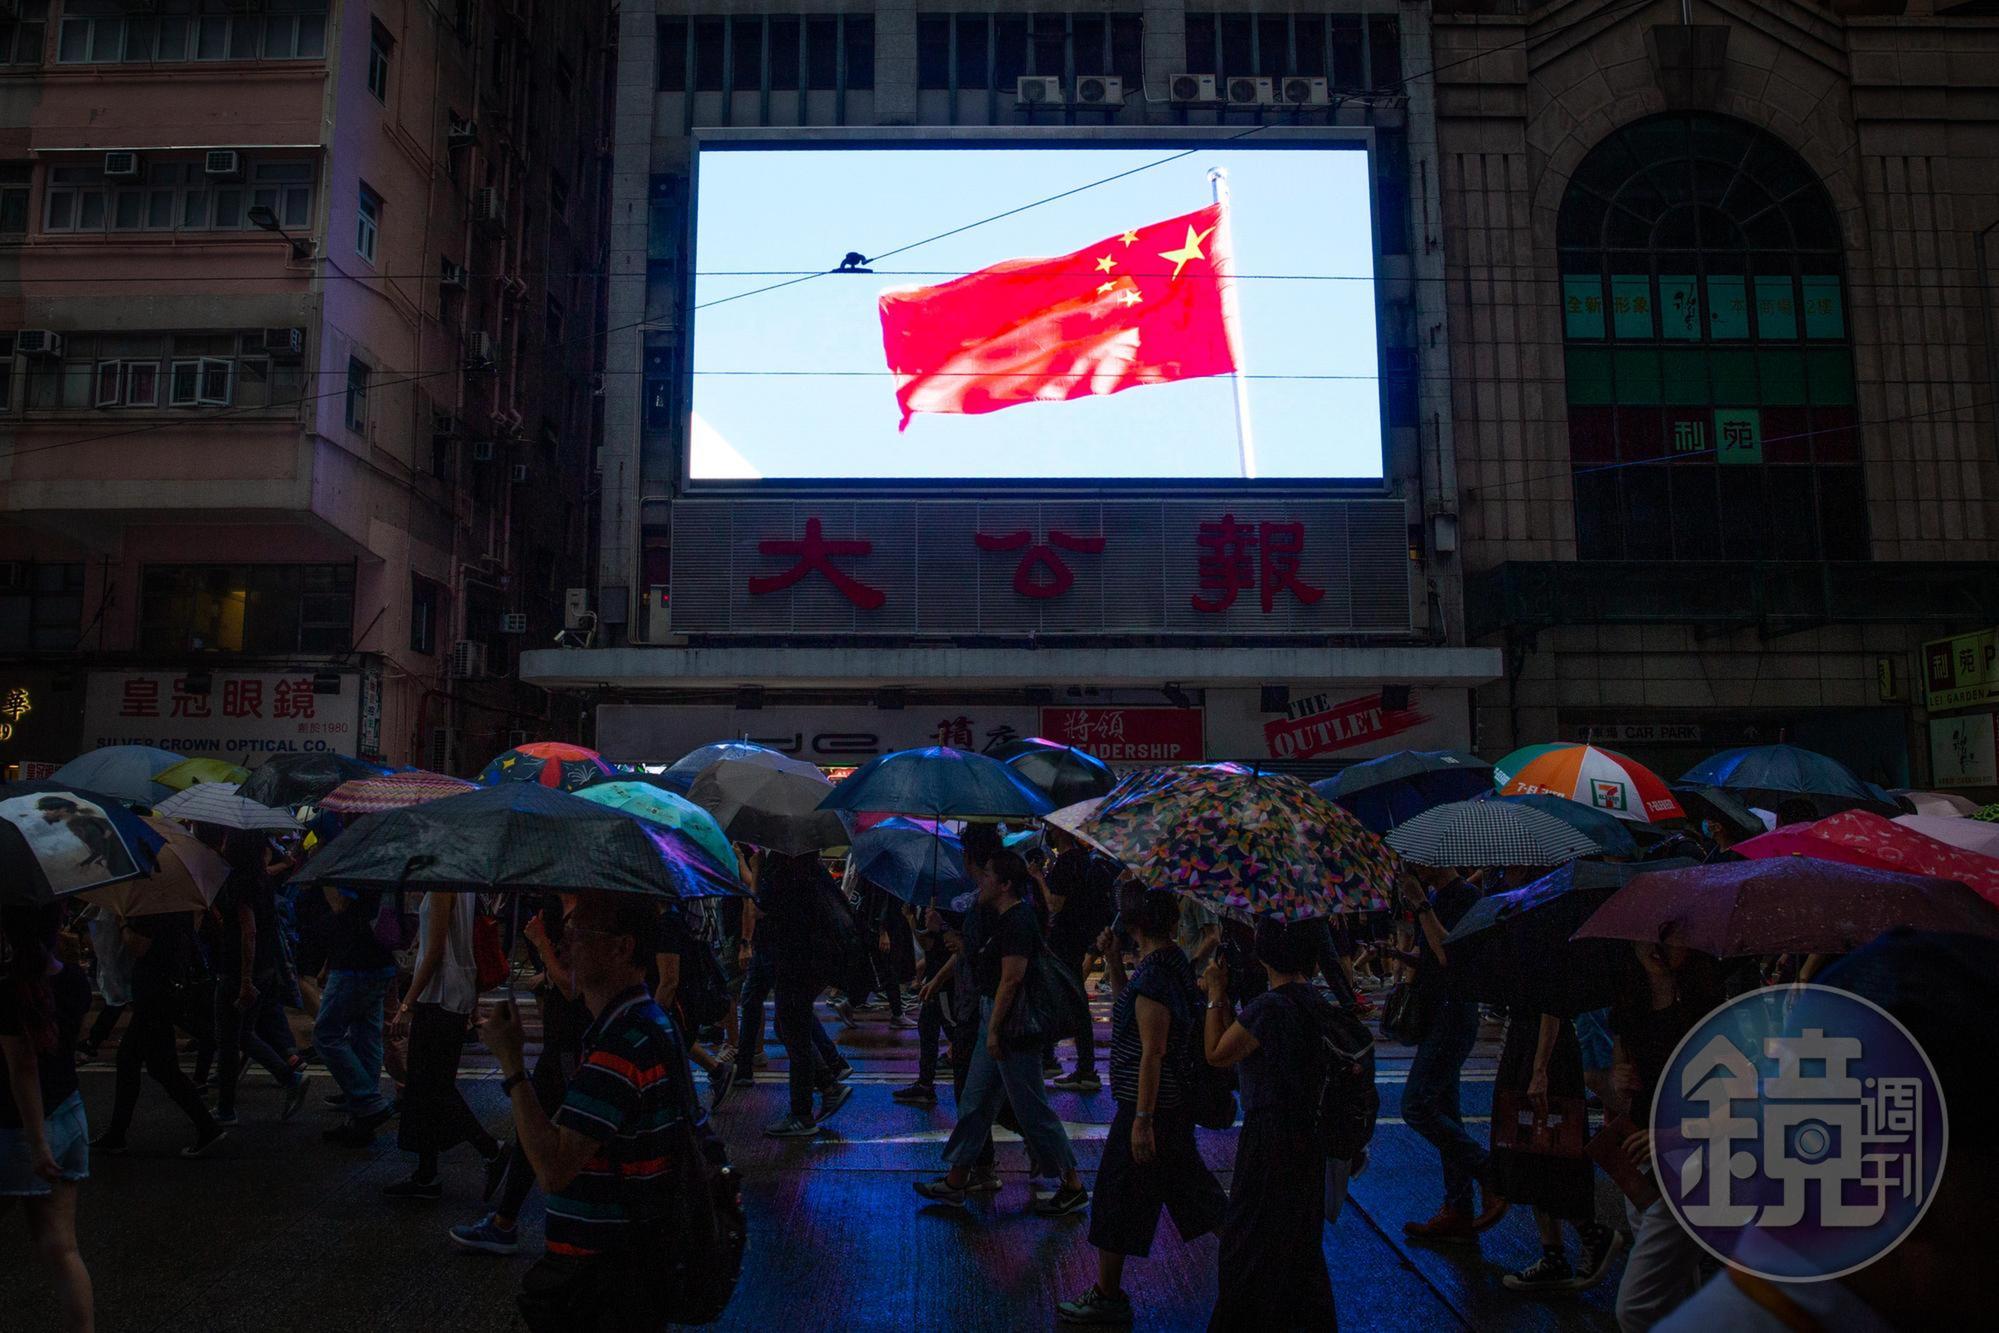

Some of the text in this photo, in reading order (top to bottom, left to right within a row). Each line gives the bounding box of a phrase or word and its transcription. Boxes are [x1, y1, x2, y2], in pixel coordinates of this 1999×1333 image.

[1674, 419, 1753, 451] 利苑
[748, 514, 1326, 613] 大公報
[1932, 648, 1976, 681] 利苑
[119, 677, 316, 720] 皇冠眼鏡
[1929, 689, 1985, 706] LEI GARDEN
[159, 738, 220, 752] CROWN
[225, 739, 297, 752] OPTICAL
[1274, 706, 1384, 756] OUTLET
[1624, 726, 1654, 739] CAR
[1660, 726, 1698, 739] PARK
[1076, 743, 1182, 760] ADERSHIP
